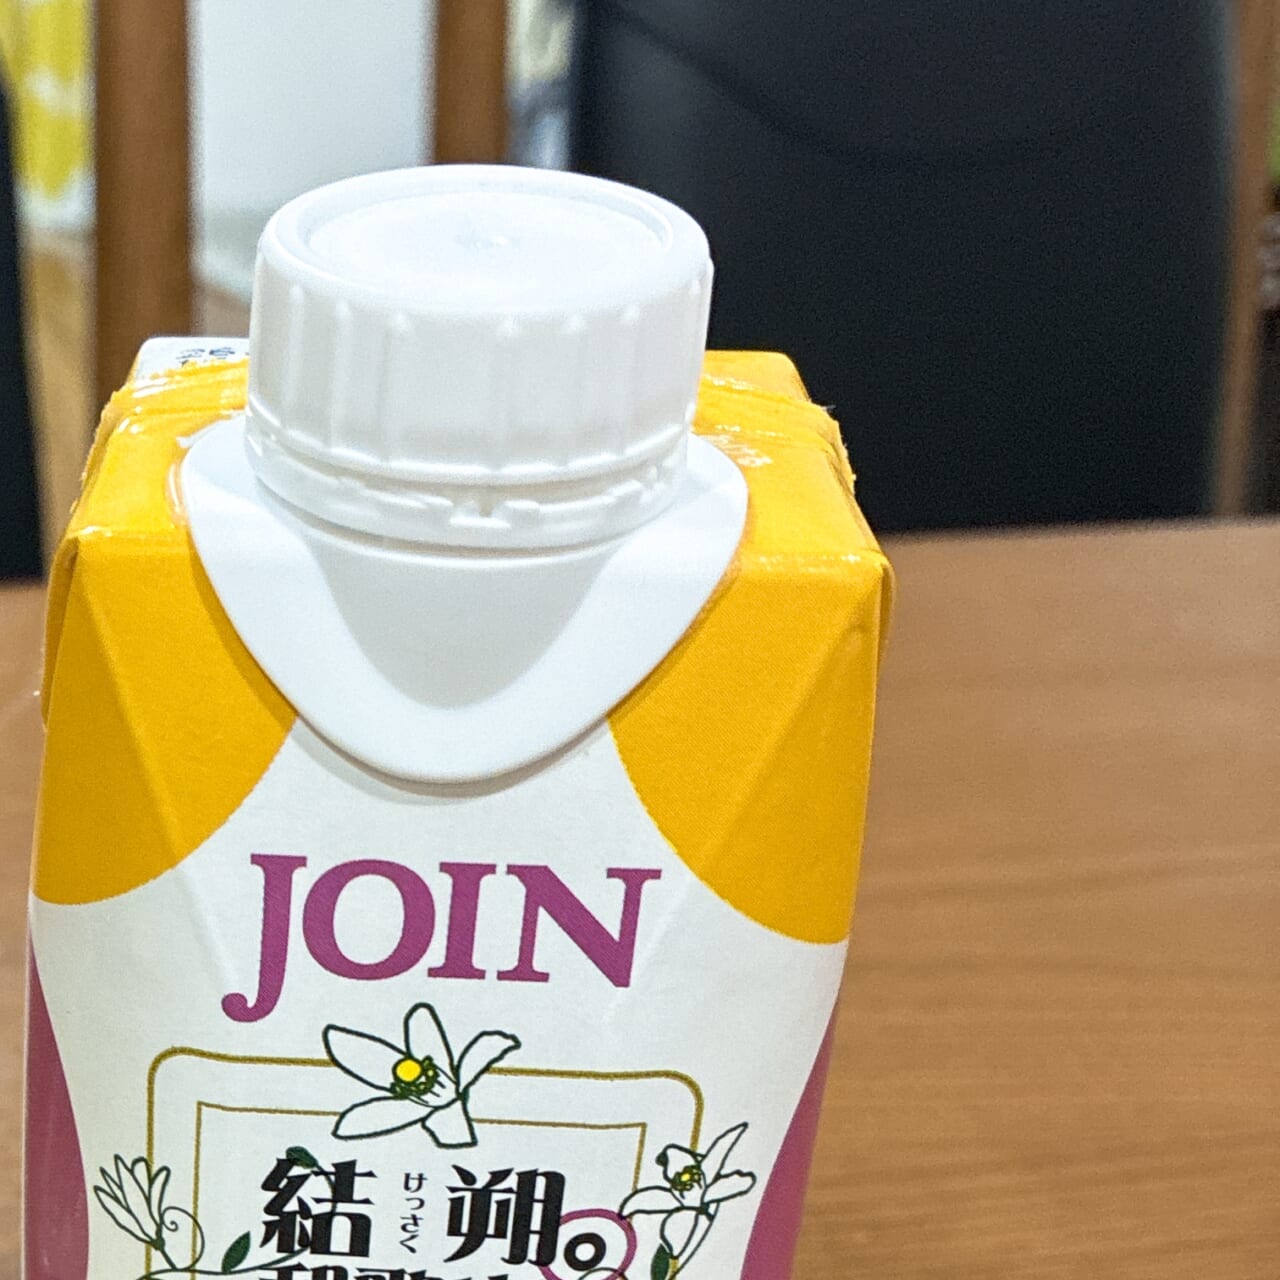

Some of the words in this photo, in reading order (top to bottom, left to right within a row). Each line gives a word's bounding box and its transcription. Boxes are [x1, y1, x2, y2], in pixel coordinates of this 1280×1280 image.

[221, 853, 662, 1023] JOIN
[399, 1172, 428, 1255] けっさく
